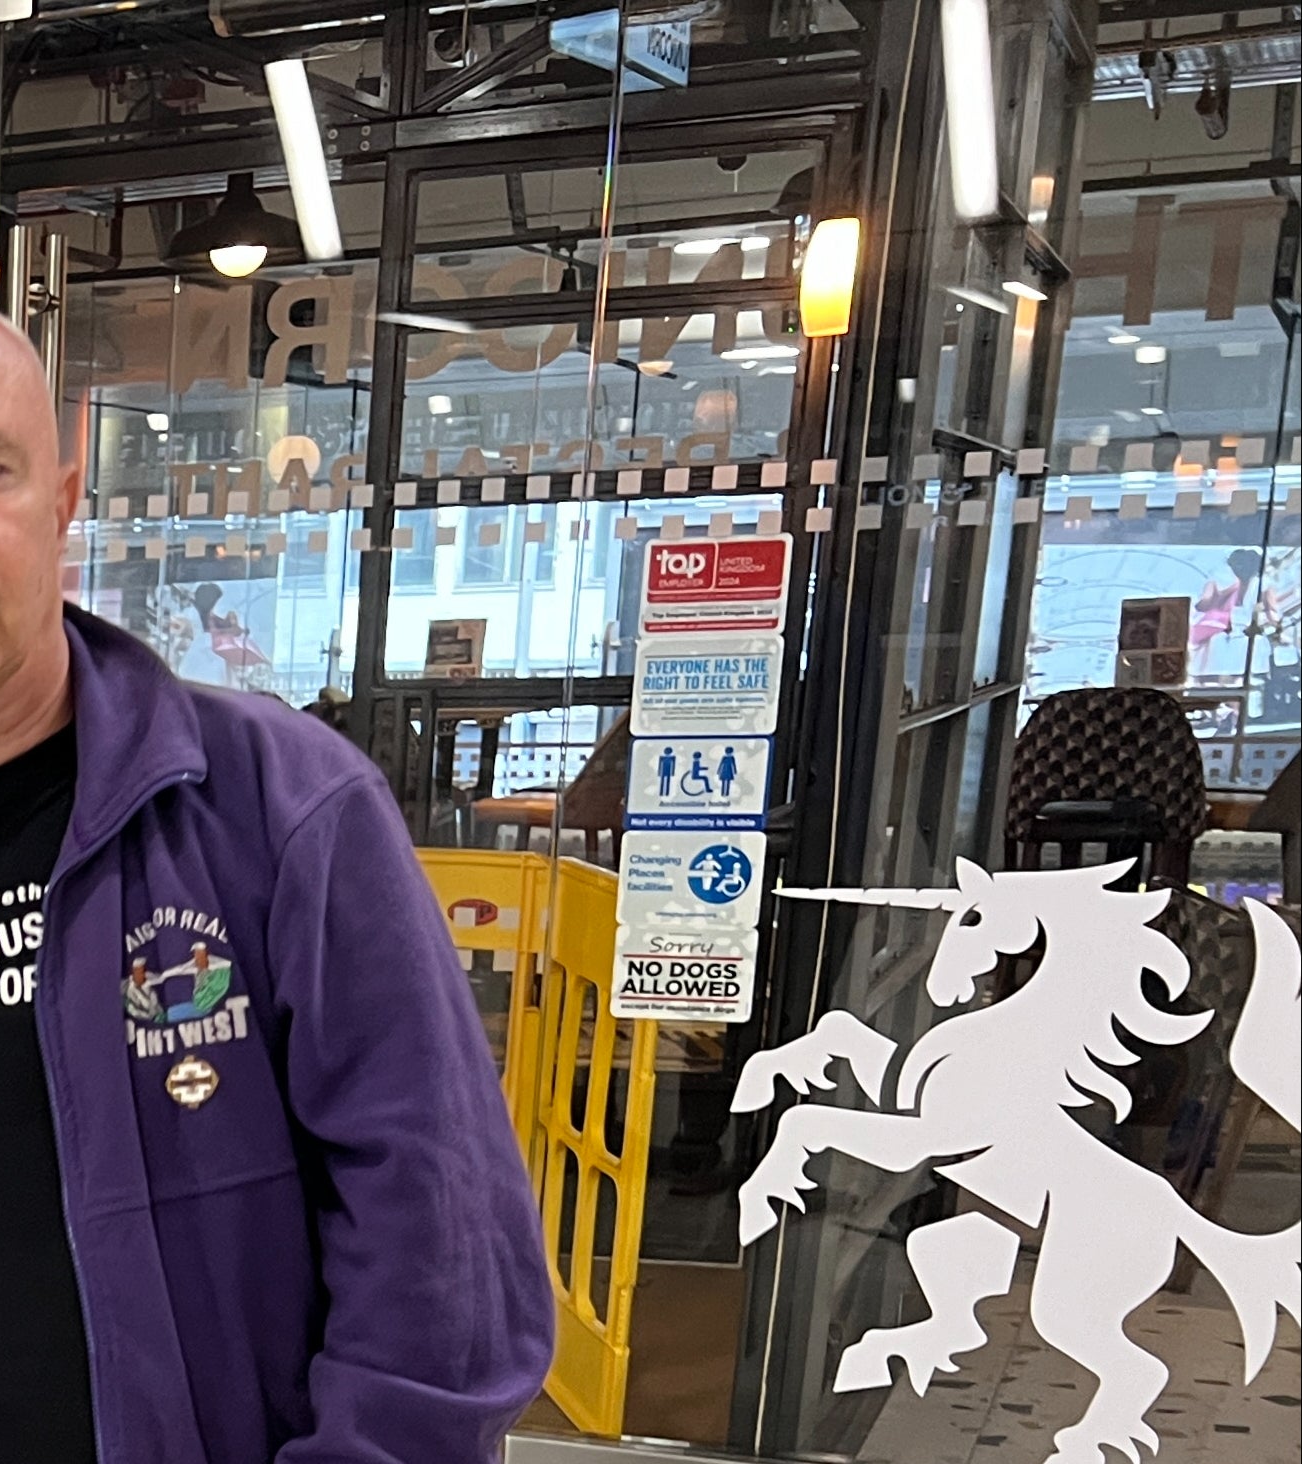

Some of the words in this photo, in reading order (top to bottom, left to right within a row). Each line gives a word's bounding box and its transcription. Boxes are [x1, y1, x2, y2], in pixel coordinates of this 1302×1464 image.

[656, 549, 706, 578] top
[647, 659, 709, 675] EVERYONE
[714, 658, 739, 673] HAS
[744, 657, 769, 673] THE
[643, 676, 680, 690] RIGHT
[685, 675, 699, 690] TO
[703, 674, 733, 690] FEEL
[737, 674, 770, 690] SAFE
[630, 818, 647, 826] Not
[648, 819, 672, 828] every
[674, 818, 715, 827] disability
[716, 818, 725, 826] is
[726, 818, 756, 826] visible
[629, 854, 682, 867] Changing
[628, 868, 665, 878] Places
[627, 881, 674, 892] facilities
[649, 935, 715, 955] Sorry
[628, 961, 663, 977] NO
[669, 962, 738, 979] DOGS
[620, 978, 741, 998] ALLOWED
[178, 995, 250, 1049] WEST
